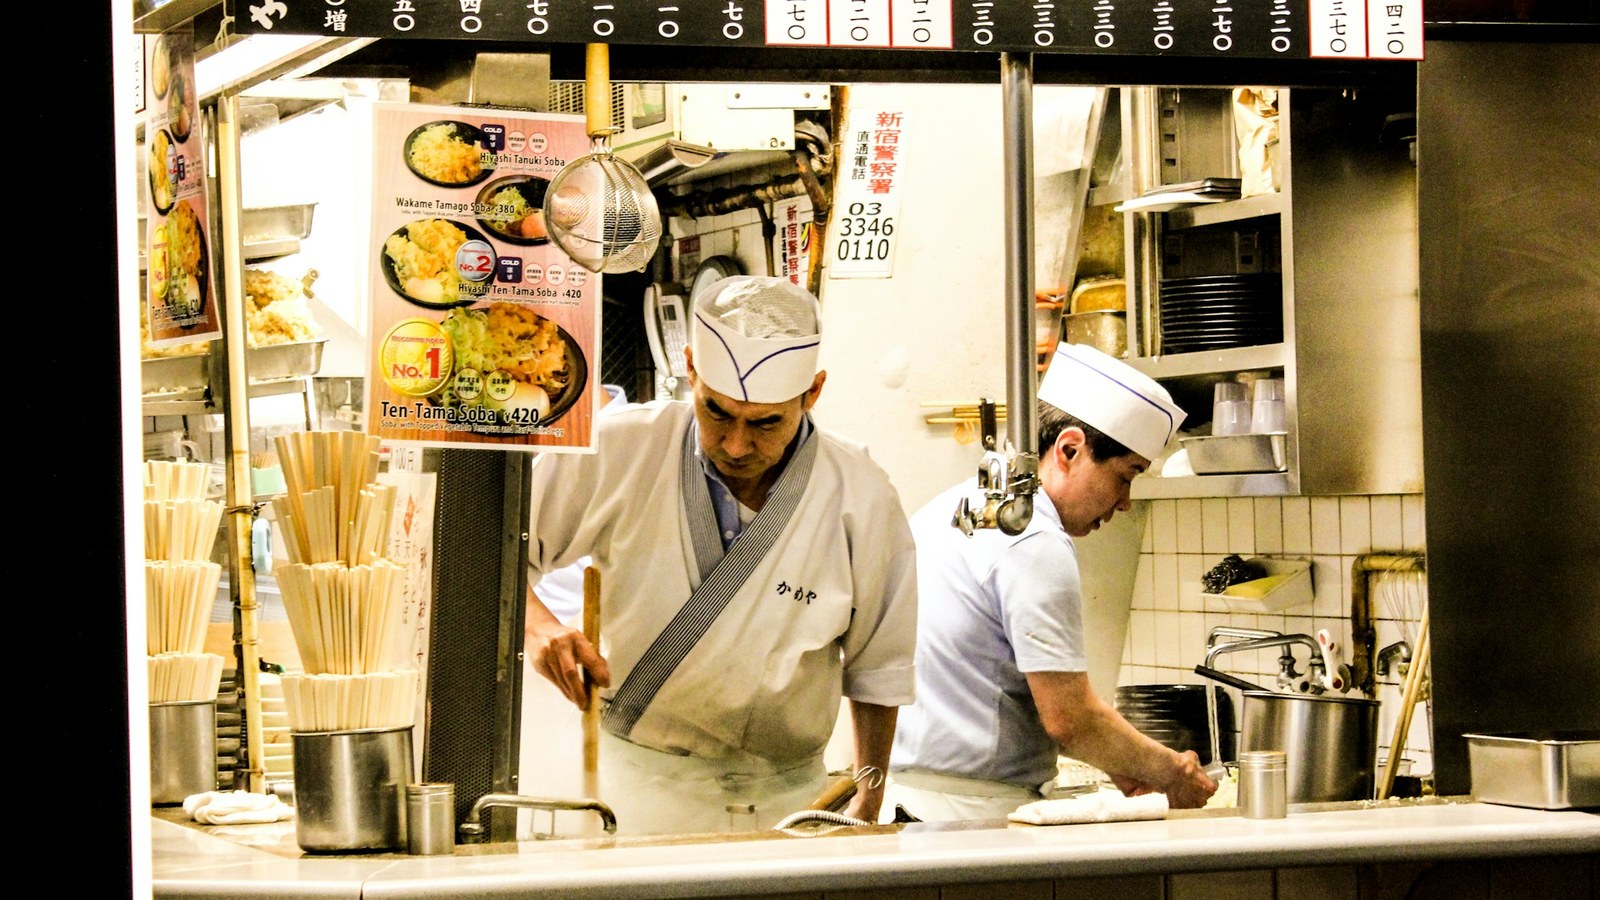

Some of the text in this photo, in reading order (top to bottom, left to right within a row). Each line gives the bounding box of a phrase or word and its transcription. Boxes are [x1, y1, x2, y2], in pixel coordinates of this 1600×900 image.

[787, 0, 806, 40] 七〇
[849, 0, 870, 41] 二〇
[480, 152, 565, 167] Hiyashi Tanuki Soba
[851, 131, 871, 180] 直通電話
[867, 111, 904, 195] 新宿警察署
[396, 197, 433, 209] Wakame
[436, 200, 468, 213] Tamago
[470, 202, 491, 213] Soba
[849, 202, 882, 216] 03
[841, 217, 894, 237] 3346
[838, 239, 890, 261] 0110
[459, 255, 492, 273] No.2
[501, 259, 520, 267] COLD
[458, 283, 490, 295] Hiyashi
[493, 286, 535, 297] Ten-Tama
[537, 287, 557, 298] Soba
[392, 347, 441, 379] No.1
[381, 401, 539, 424] Ten-Tama Soba ¥420
[777, 581, 817, 605] かめや
